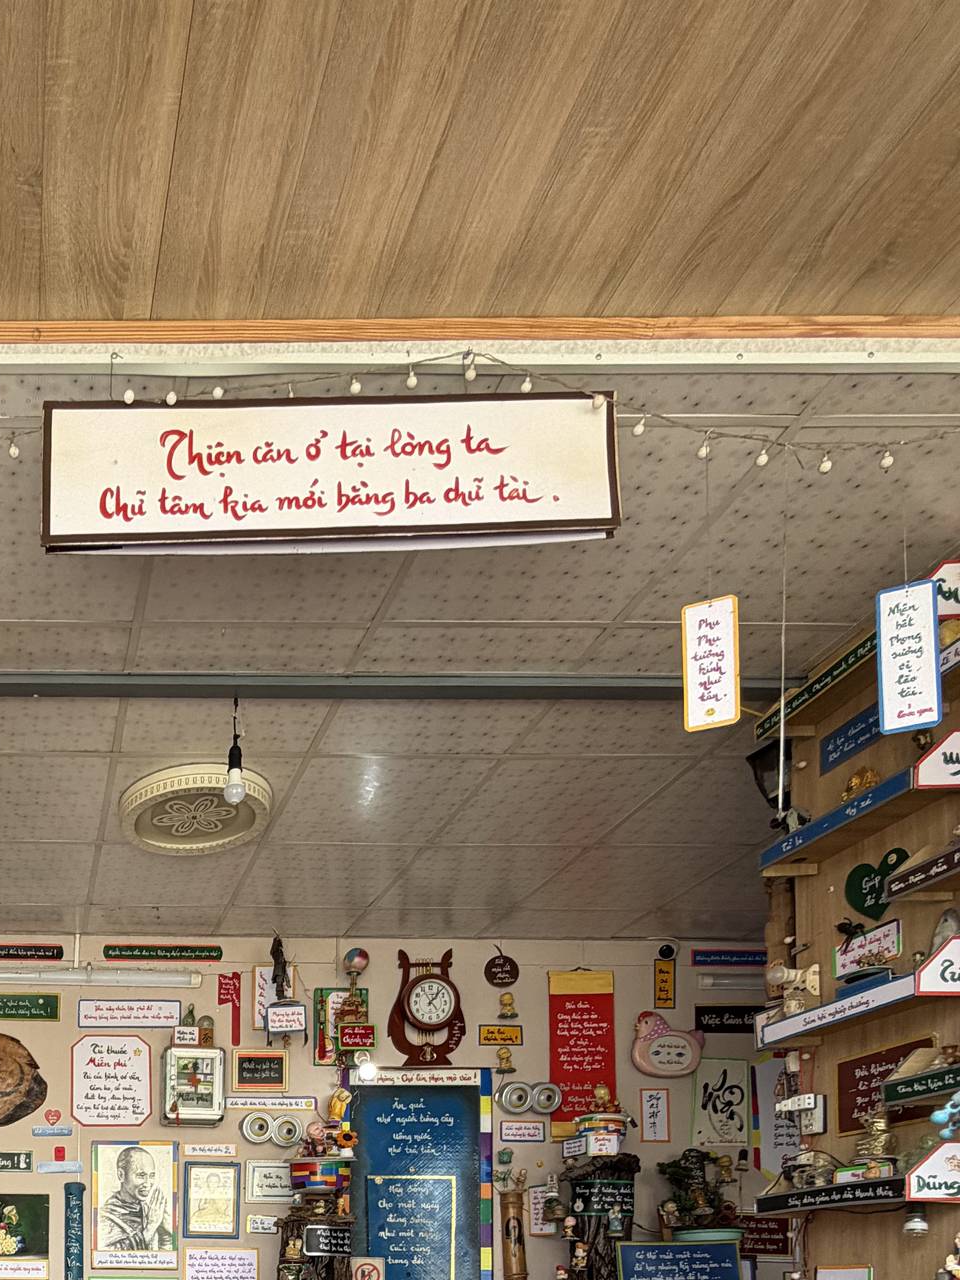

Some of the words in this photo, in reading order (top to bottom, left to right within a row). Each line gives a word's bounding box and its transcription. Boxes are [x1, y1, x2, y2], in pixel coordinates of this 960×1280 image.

[160, 429, 243, 479] Thiện
[253, 444, 298, 465] căn
[306, 431, 328, 461] ở
[336, 434, 375, 468] tại
[384, 428, 451, 469] lòng
[460, 425, 508, 456] ta
[99, 487, 147, 521] Chữ
[158, 488, 213, 520] tâm
[219, 487, 268, 521] kia
[276, 478, 328, 510] mới
[336, 481, 396, 516] bằng
[404, 480, 436, 509] ba
[444, 476, 485, 507] chữ
[392, 1098, 407, 1110] Ăn
[409, 1098, 426, 1111] quả
